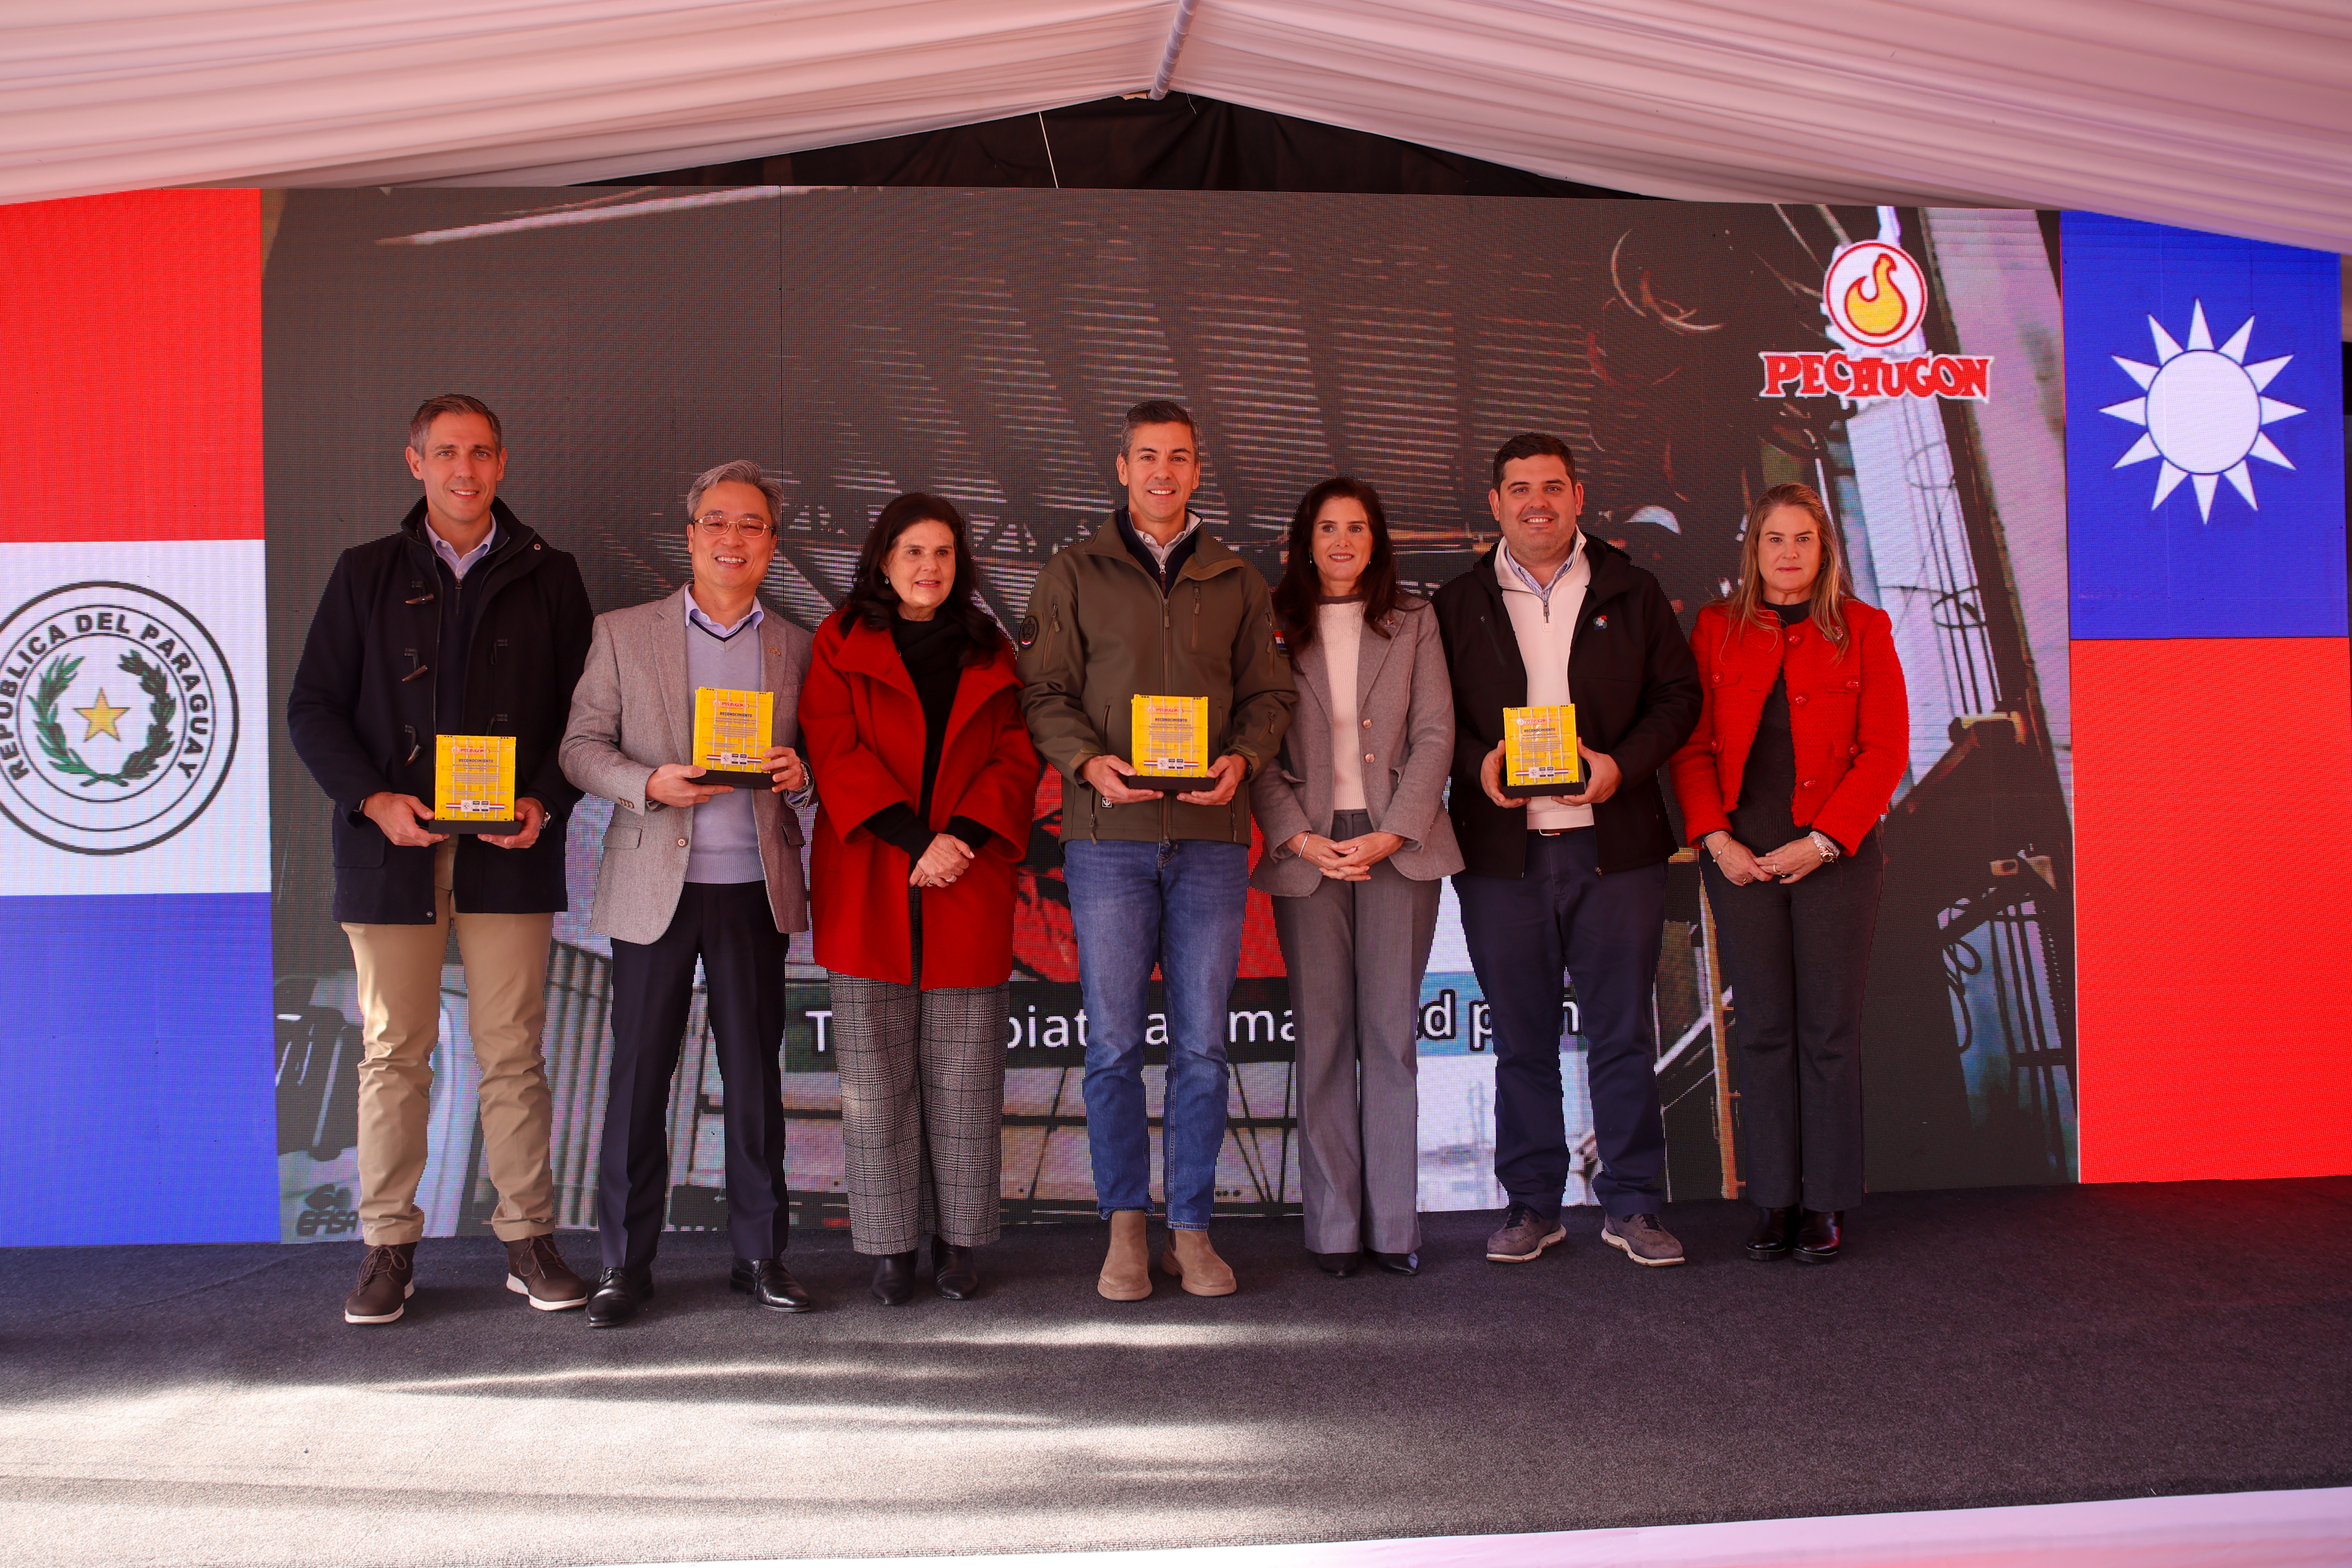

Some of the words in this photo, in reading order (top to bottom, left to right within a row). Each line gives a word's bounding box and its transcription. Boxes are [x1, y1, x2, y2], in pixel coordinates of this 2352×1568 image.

[1760, 351, 1994, 403] PECHUGON
[75, 613, 130, 633] DEL
[140, 624, 209, 778] PARAGUAY
